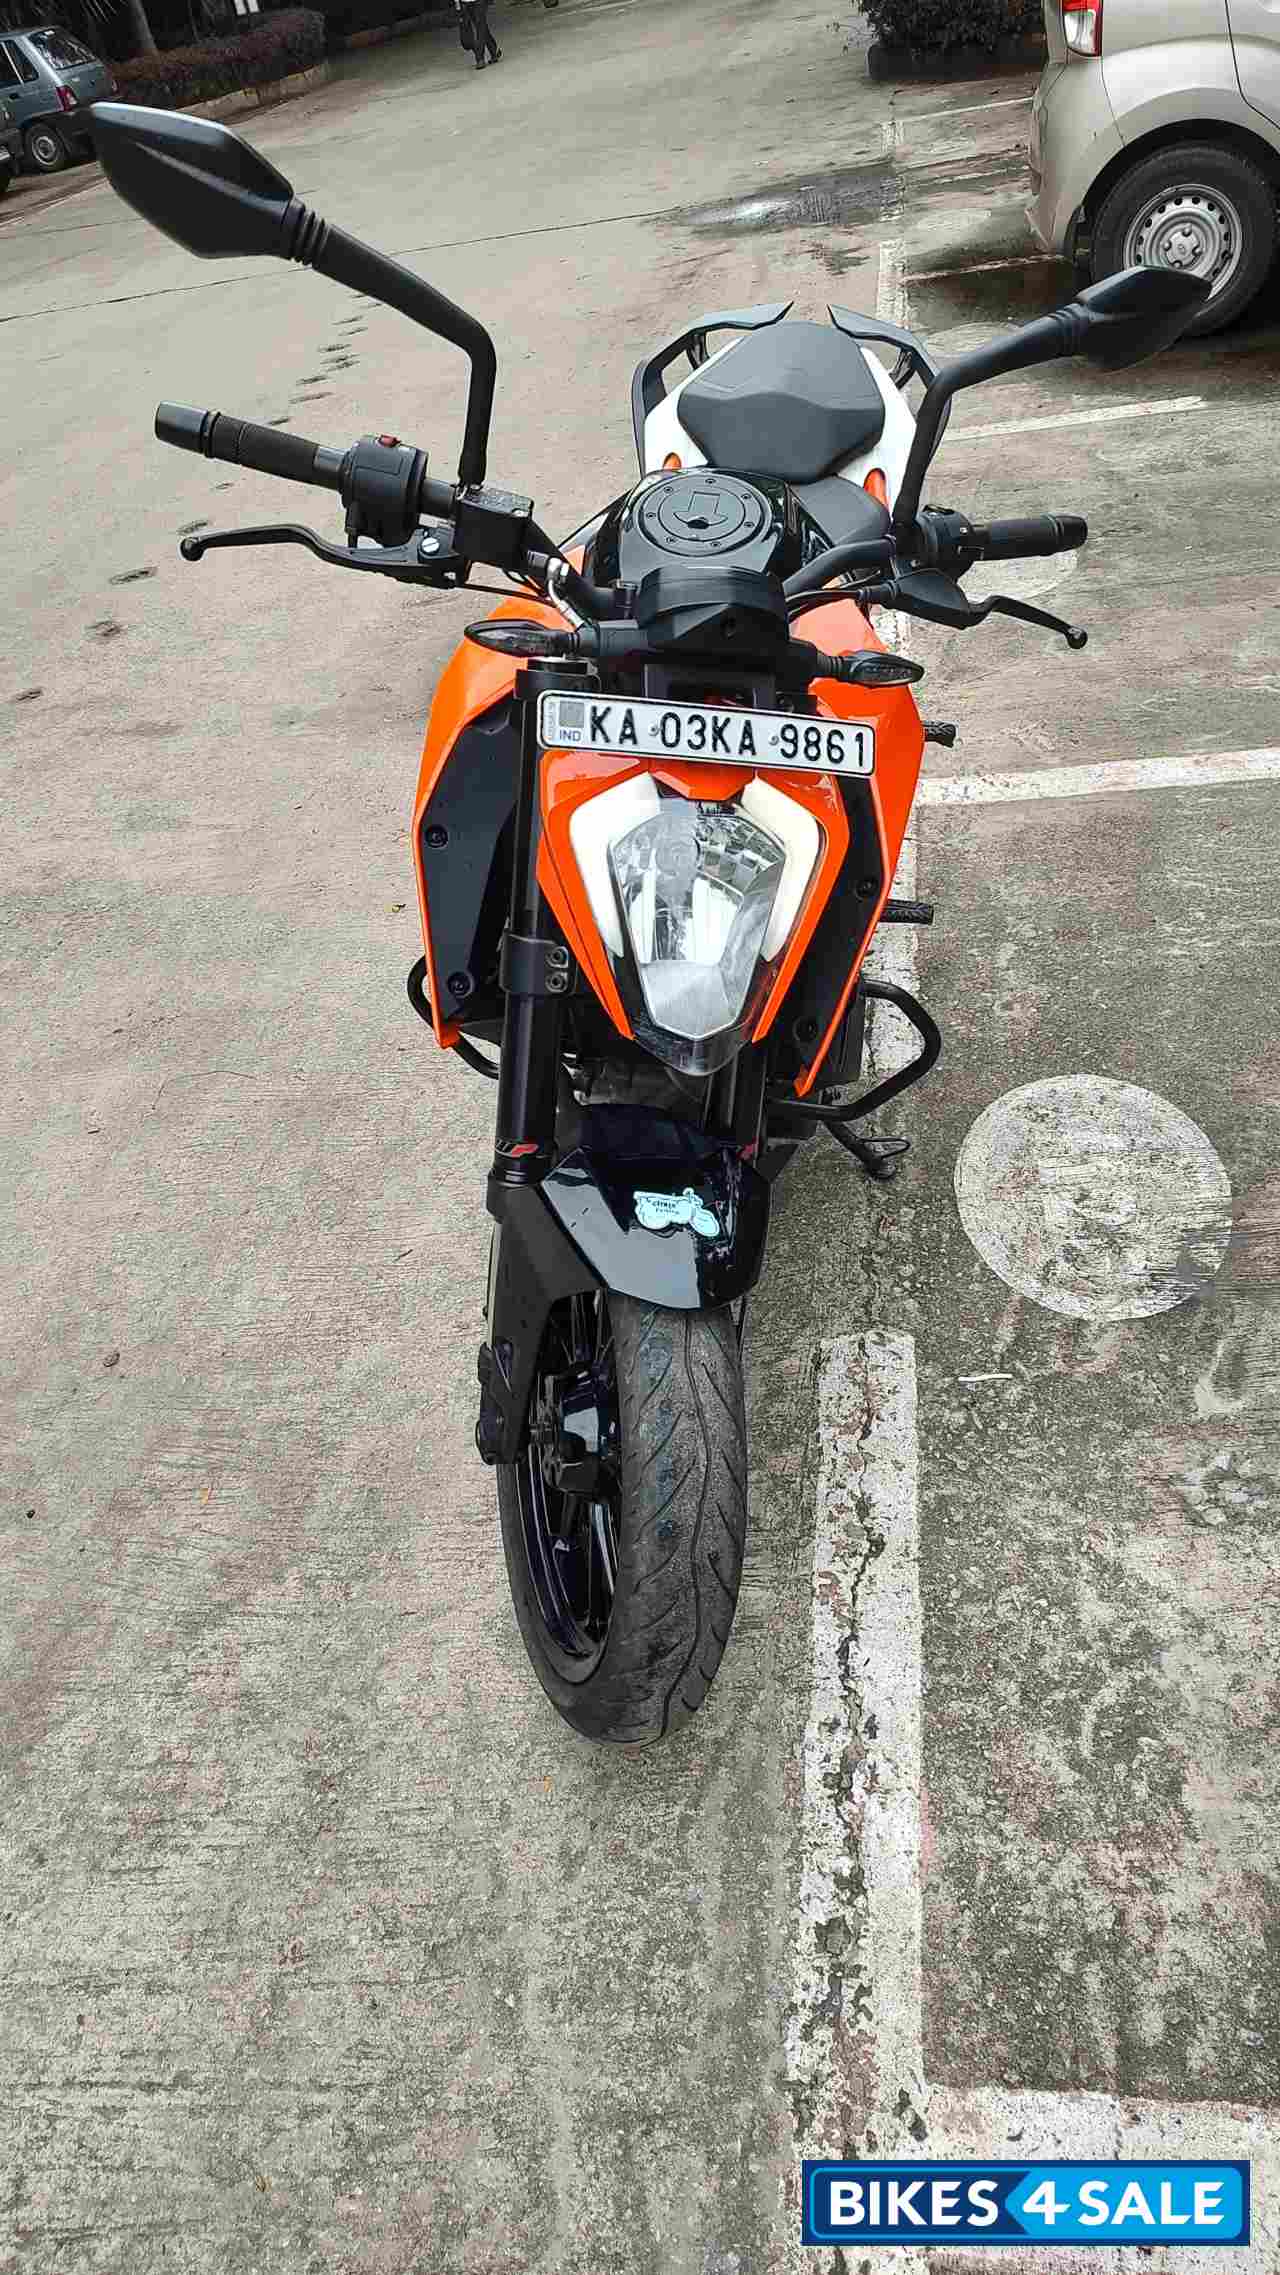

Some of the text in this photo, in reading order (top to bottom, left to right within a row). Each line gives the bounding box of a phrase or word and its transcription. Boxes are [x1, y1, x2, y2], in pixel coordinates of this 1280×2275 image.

[559, 729, 582, 742] IND
[590, 705, 639, 745] KA
[779, 723, 865, 768] 9861
